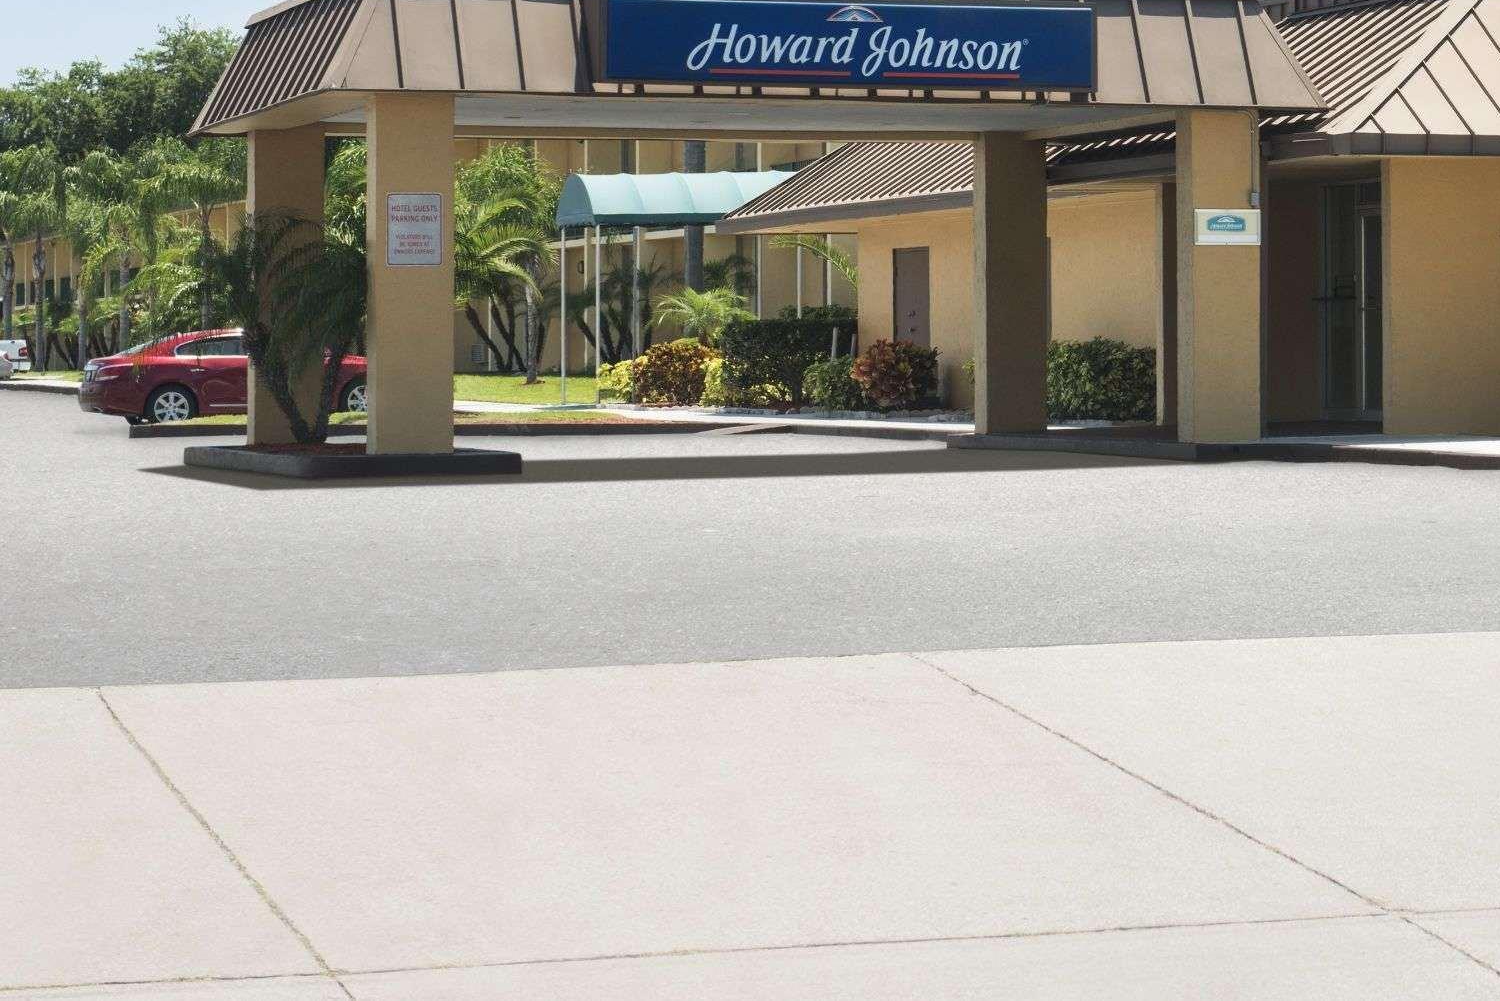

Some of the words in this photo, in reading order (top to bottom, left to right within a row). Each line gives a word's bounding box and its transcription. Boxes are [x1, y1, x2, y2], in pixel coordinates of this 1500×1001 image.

[686, 23, 859, 70] Howard
[861, 26, 1025, 76] Johnson
[391, 204, 411, 212] HOTEL
[413, 204, 438, 212] GUESTS
